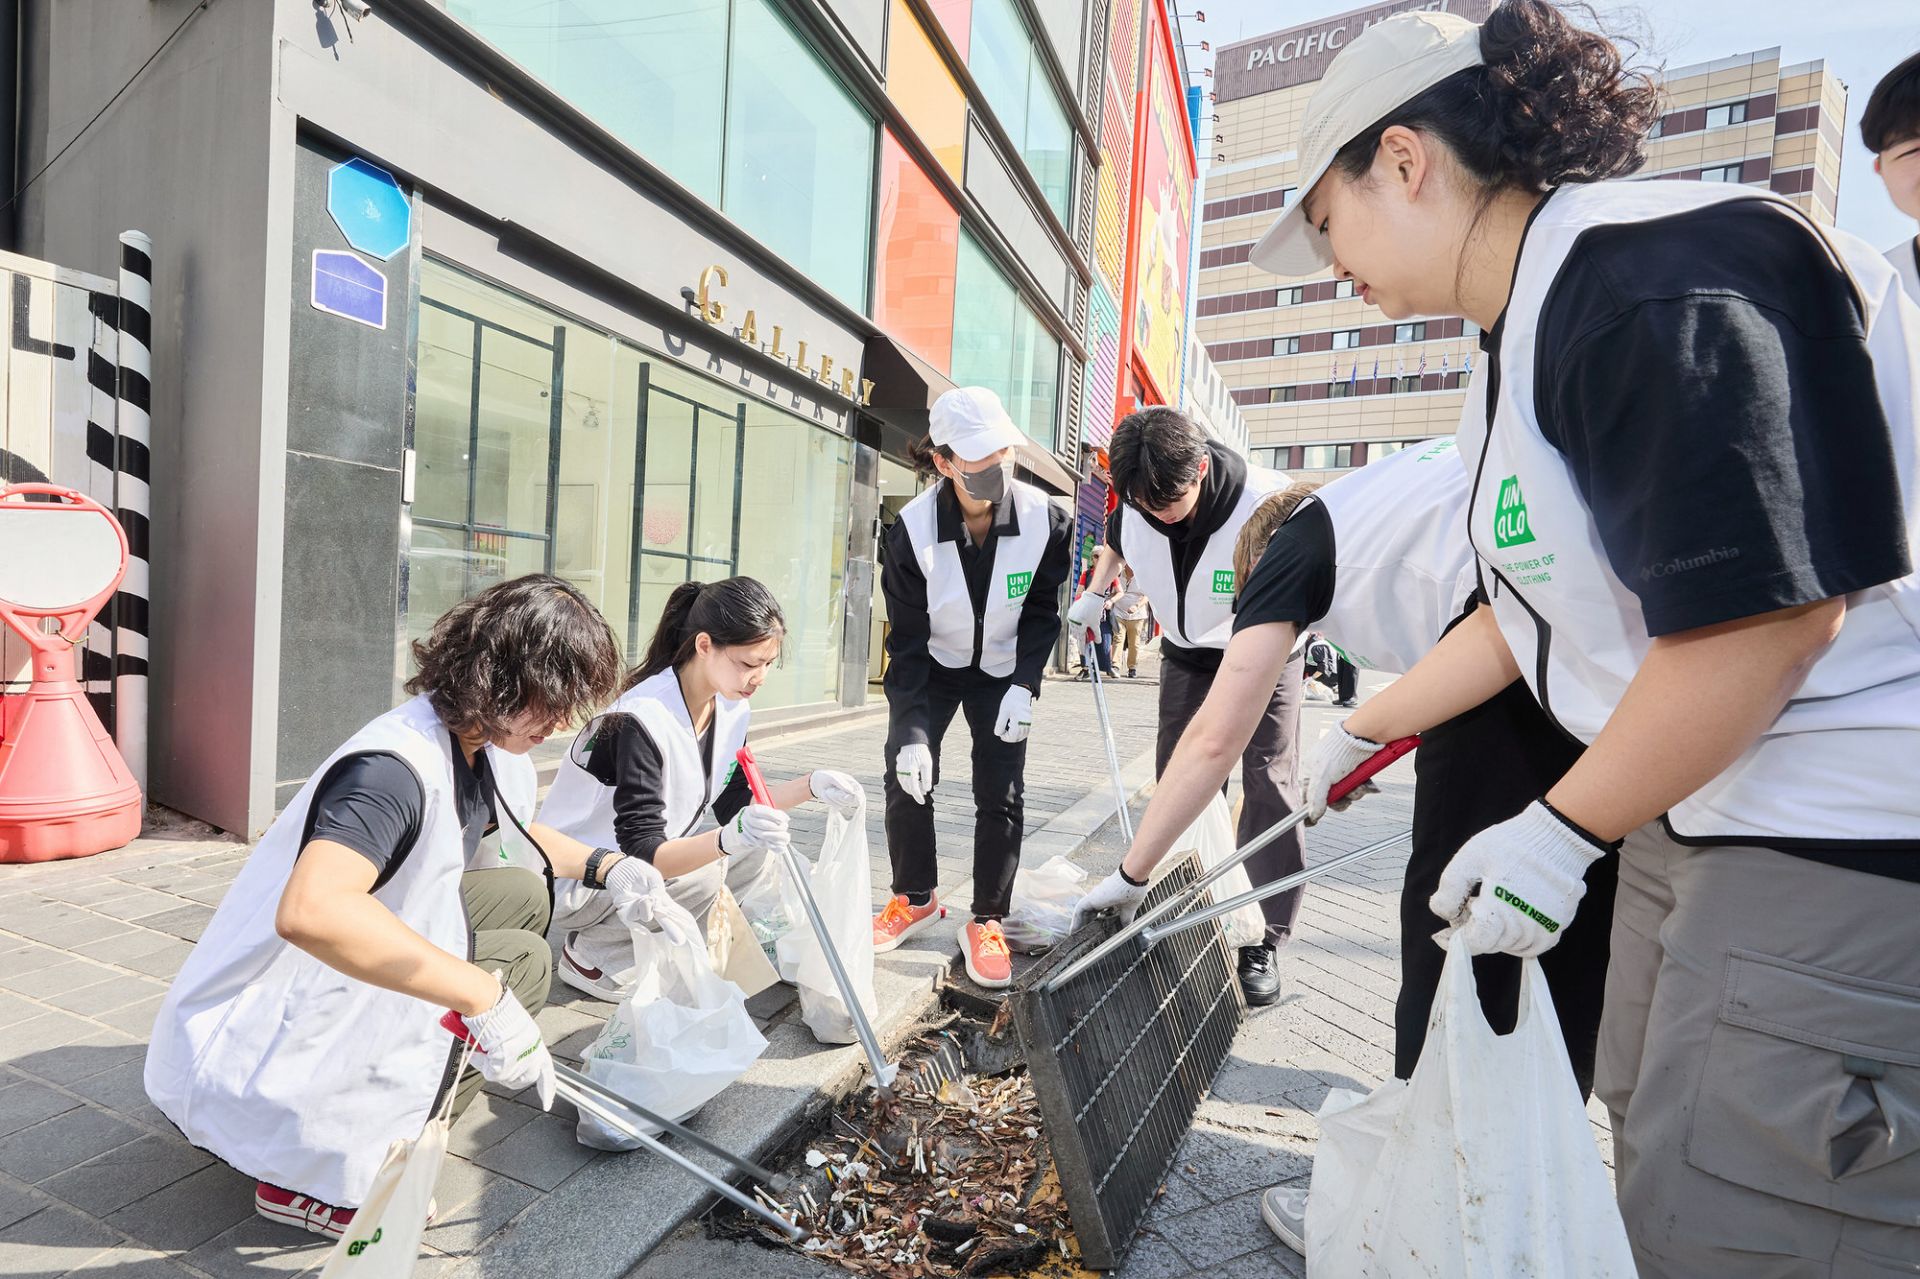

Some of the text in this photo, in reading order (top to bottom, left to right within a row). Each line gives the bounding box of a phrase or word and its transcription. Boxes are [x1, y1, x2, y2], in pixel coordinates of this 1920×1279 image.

[1247, 26, 1346, 71] PACIFIC
[698, 264, 876, 407] GALLERY
[1497, 510, 1525, 543] QLO
[1542, 553, 1555, 566] OF
[1650, 546, 1740, 578] Columbia
[1009, 574, 1028, 586] UNI
[1494, 885, 1560, 933] GREEN ROAD
